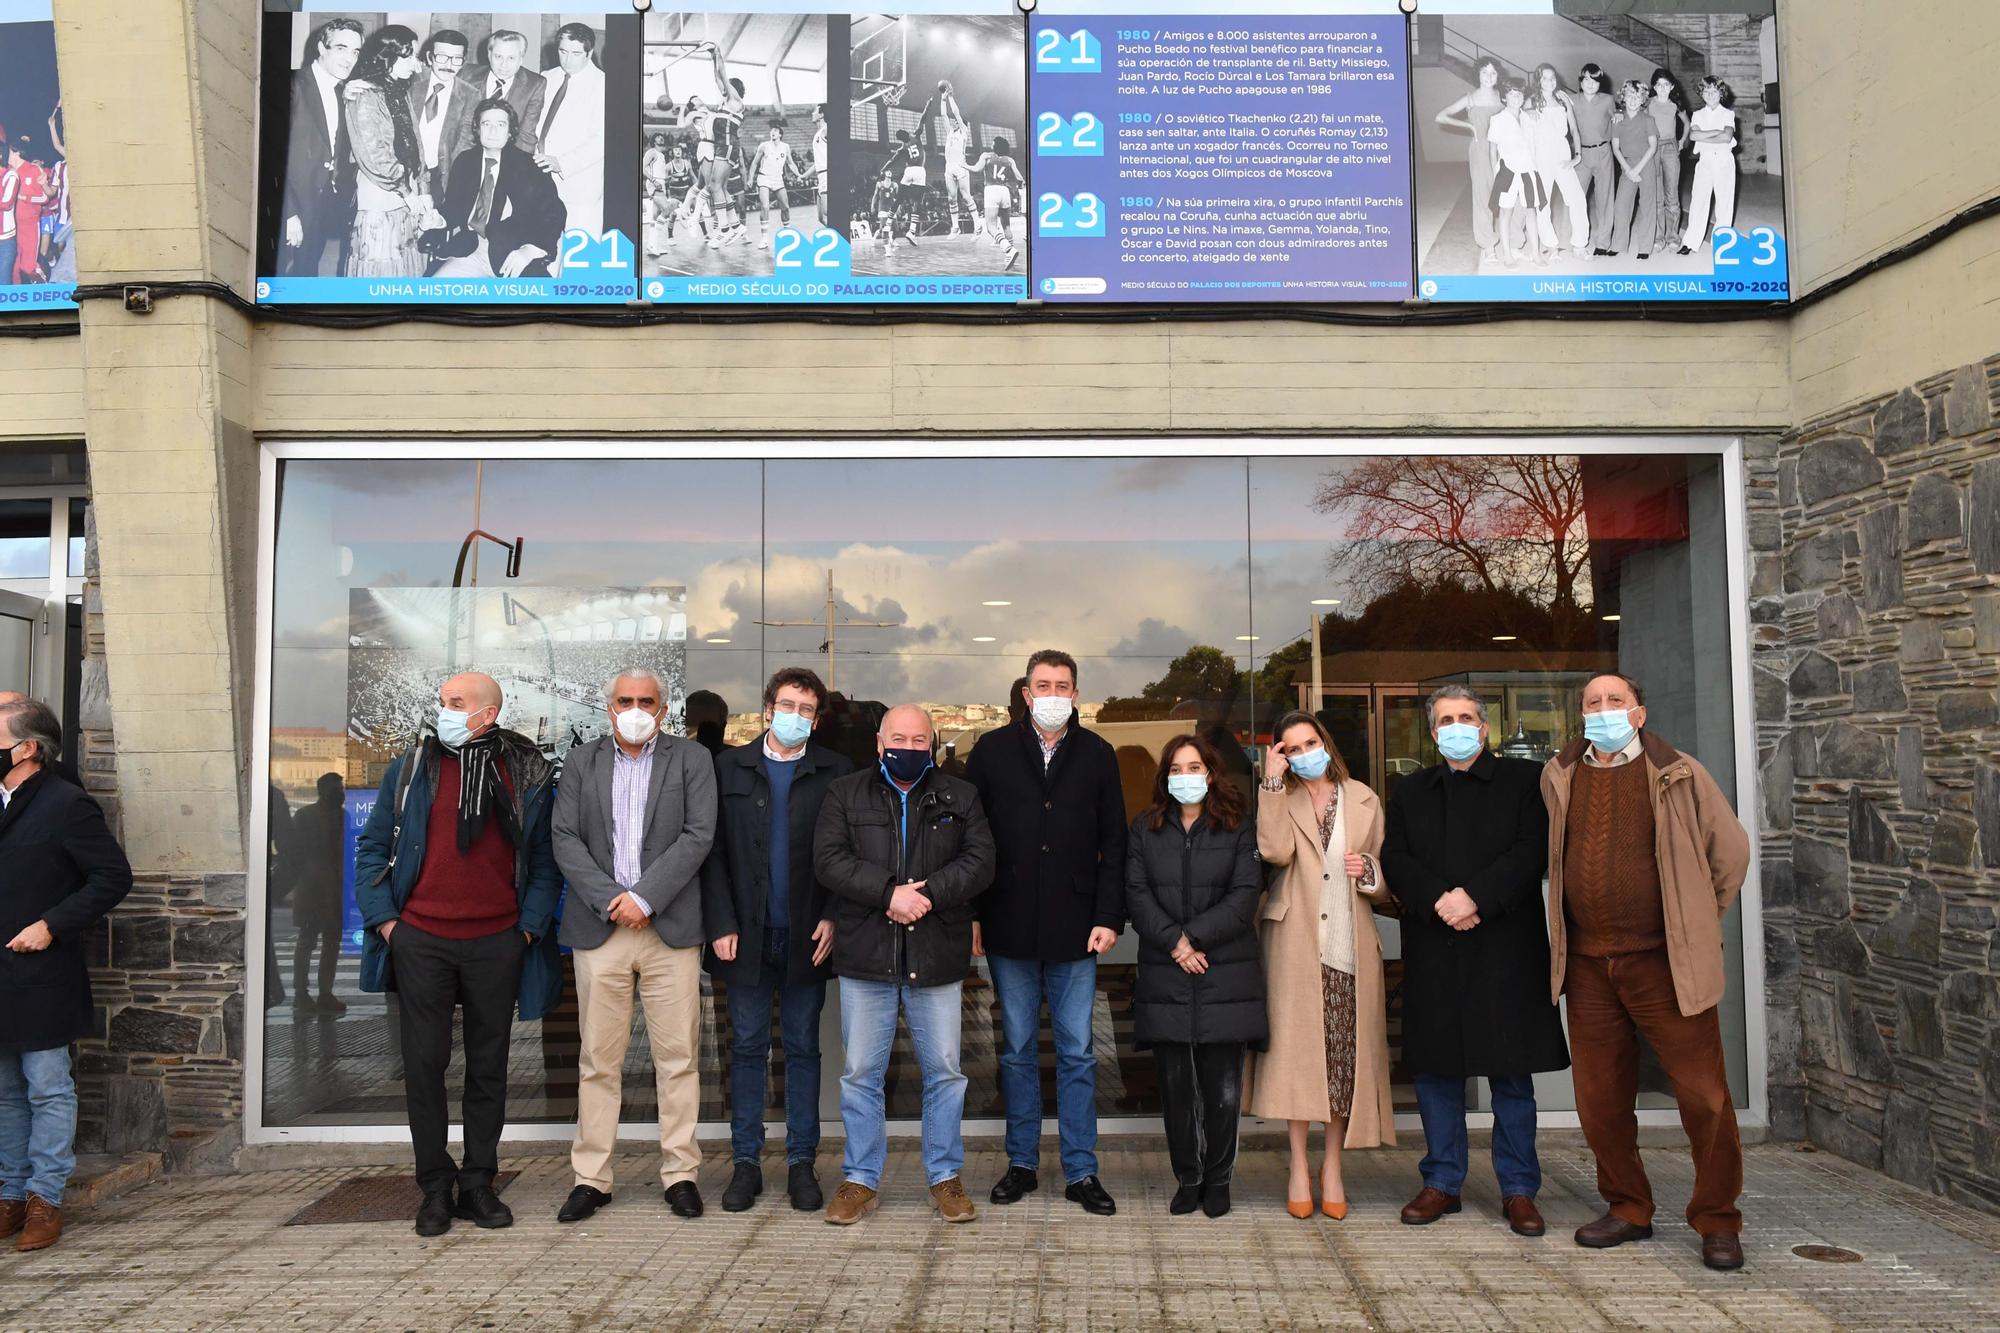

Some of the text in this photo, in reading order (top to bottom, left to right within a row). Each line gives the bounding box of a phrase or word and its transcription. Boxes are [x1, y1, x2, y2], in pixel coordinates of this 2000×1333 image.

[1117, 30, 1150, 40] 1980
[1163, 30, 1204, 41] Amigos
[1207, 32, 1213, 40] e
[1216, 30, 1249, 40] 8.000
[1252, 31, 1305, 40] asistentes
[1308, 32, 1367, 41] arrouparon
[1370, 32, 1377, 40] a
[1037, 28, 1095, 64] 21
[1117, 44, 1151, 53] Pucho
[1154, 44, 1190, 53] Boedo
[1209, 43, 1247, 53] festival
[1250, 43, 1297, 54] benéfico
[1300, 46, 1324, 54] para
[1327, 43, 1373, 53] financiar
[1139, 57, 1192, 68] operación
[1195, 57, 1209, 67] de
[1212, 57, 1273, 68] transplante
[1276, 57, 1289, 67] de
[1293, 57, 1305, 66] ril.
[1308, 57, 1338, 68] Betty
[1341, 57, 1389, 68] Missiego,
[1118, 71, 1143, 80] Juan
[1147, 71, 1181, 81] Pardo,
[1184, 71, 1214, 80] Rocío
[1218, 71, 1252, 80] Dúrcal
[1265, 71, 1284, 80] Los
[1287, 71, 1326, 80] Tamara
[1329, 70, 1373, 80] brillaron
[1376, 72, 1394, 80] esa
[1118, 84, 1331, 96] noite. A luz de Pucho apagouse en 1986
[1118, 112, 1151, 123] 1980
[1164, 113, 1173, 123] O
[1177, 113, 1225, 123] soviético
[1227, 113, 1286, 123] Tkachenko
[1289, 113, 1318, 124] (2,21)
[1321, 113, 1334, 122] fai
[1354, 113, 1383, 123] mate,
[1039, 112, 1097, 147] 22
[1168, 127, 1199, 137] saltar,
[1202, 128, 1226, 136] ante
[1229, 127, 1257, 136] Italia.
[1260, 127, 1270, 136] O
[1273, 127, 1316, 136] coruñés
[1319, 127, 1356, 138] Romay
[1359, 126, 1388, 137] (2,13)
[907, 144, 920, 159] 15
[1119, 140, 1147, 150] lanza
[1150, 142, 1174, 150] ante
[1194, 140, 1238, 152] xogador
[1241, 140, 1283, 150] francés.
[1286, 140, 1330, 150] Ocorreu
[1333, 142, 1347, 150] no
[1350, 140, 1388, 150] Torneo
[1119, 154, 1391, 165] Internacional, que foi un cuadrangular de alto nivel
[1119, 168, 1332, 179] antes dos Xogos Olímpicos de Moscova
[1120, 196, 1153, 206] 1980
[1166, 197, 1181, 207] Na
[1206, 197, 1250, 208] primeira
[1253, 197, 1275, 207] xira,
[1289, 198, 1321, 208] grupo
[1325, 196, 1361, 206] infantil
[1364, 196, 1403, 206] Parchís
[1040, 192, 1098, 228] 23
[1120, 211, 1160, 220] recalou
[1179, 211, 1221, 221] Coruña,
[1224, 210, 1256, 220] cunha
[1259, 210, 1312, 220] actuación
[1315, 212, 1336, 221] que
[1339, 210, 1366, 220] abriu
[1130, 226, 1163, 236] grupo
[1167, 225, 1180, 234] Le
[1183, 224, 1209, 234] Nins.
[1212, 224, 1227, 234] Na
[1230, 224, 1264, 235] imaxe,
[1268, 224, 1312, 235] Gemma,
[1315, 224, 1361, 235] Yolanda,
[1364, 224, 1390, 235] Tino,
[564, 229, 627, 268] 21
[776, 229, 840, 267] 22
[1121, 237, 1387, 249] Óscar e David posan con dous admiradores antes
[1714, 227, 1776, 265] 23
[1121, 252, 1289, 263] do concerto, ateigado de xente
[369, 284, 634, 296] UNHA HISTORIA VISUAL 1970-2020
[687, 283, 736, 295] MEDIO
[741, 281, 801, 296] SÉCULO
[806, 283, 829, 295] DO
[833, 284, 900, 295] PALACIO
[905, 284, 937, 294] DOS
[941, 284, 1023, 294] DEPORTES
[1146, 280, 1175, 288] SÉCULO
[1340, 280, 1367, 288] VISUAL
[1533, 281, 1788, 294] UNHA HISTORIA VISUAL 1970-2020
